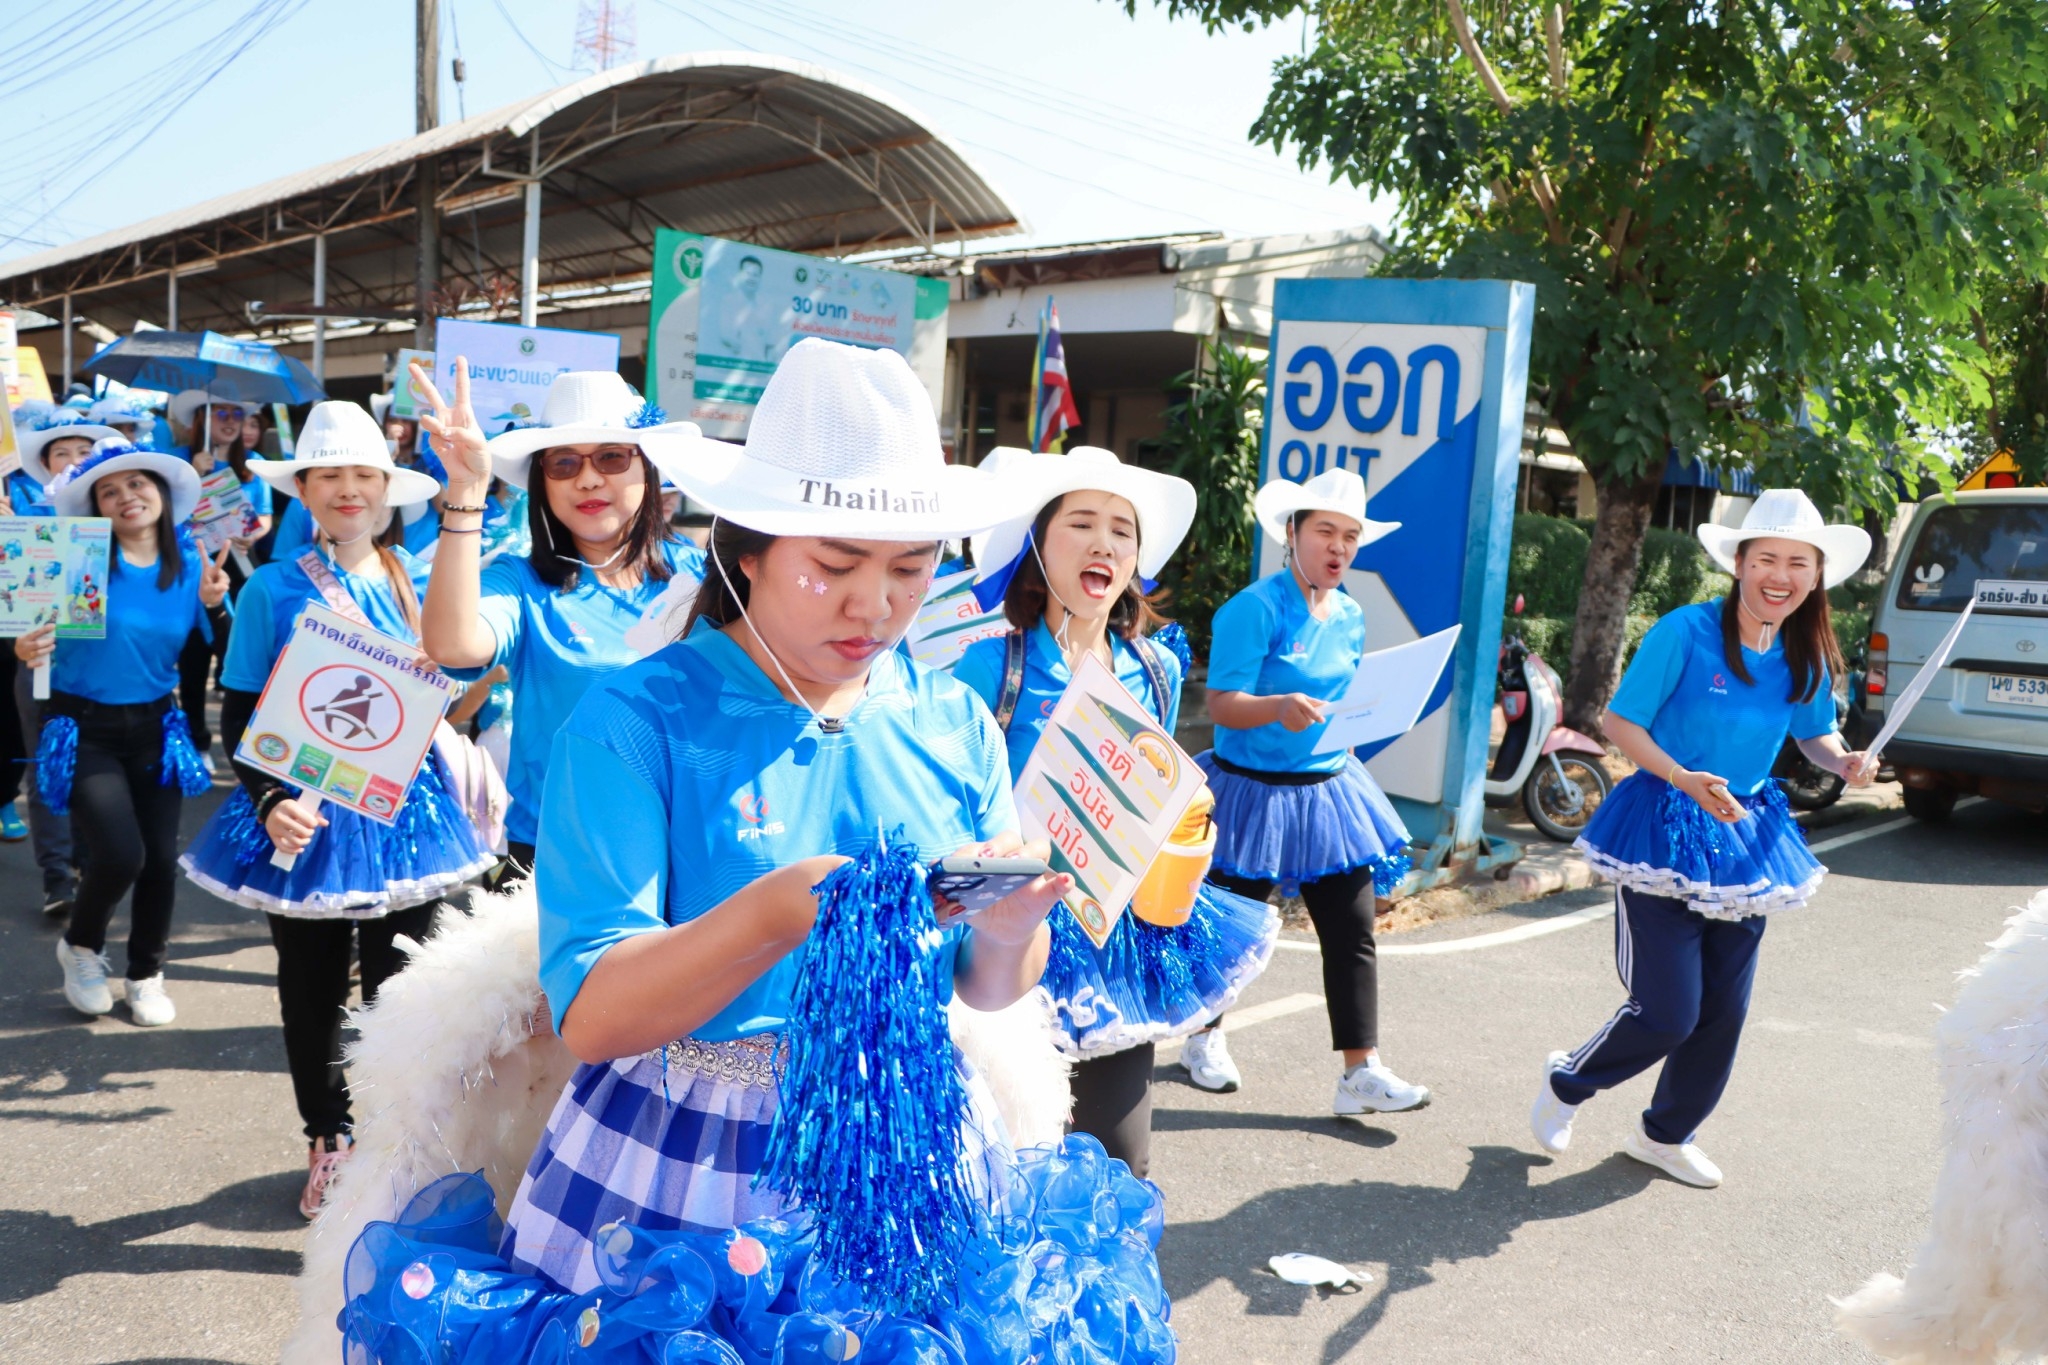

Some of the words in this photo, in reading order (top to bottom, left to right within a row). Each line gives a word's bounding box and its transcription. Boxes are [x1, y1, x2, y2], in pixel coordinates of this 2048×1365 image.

[792, 296, 812, 314] 30
[817, 302, 847, 319] บาท
[1284, 344, 1461, 440] ออก
[1278, 440, 1381, 491] OUT
[799, 479, 941, 514] Thailand
[2018, 679, 2048, 695] 533
[1098, 738, 1136, 781] สติ
[1070, 767, 1115, 831] วินัย
[1047, 808, 1089, 869] น้ำใจ
